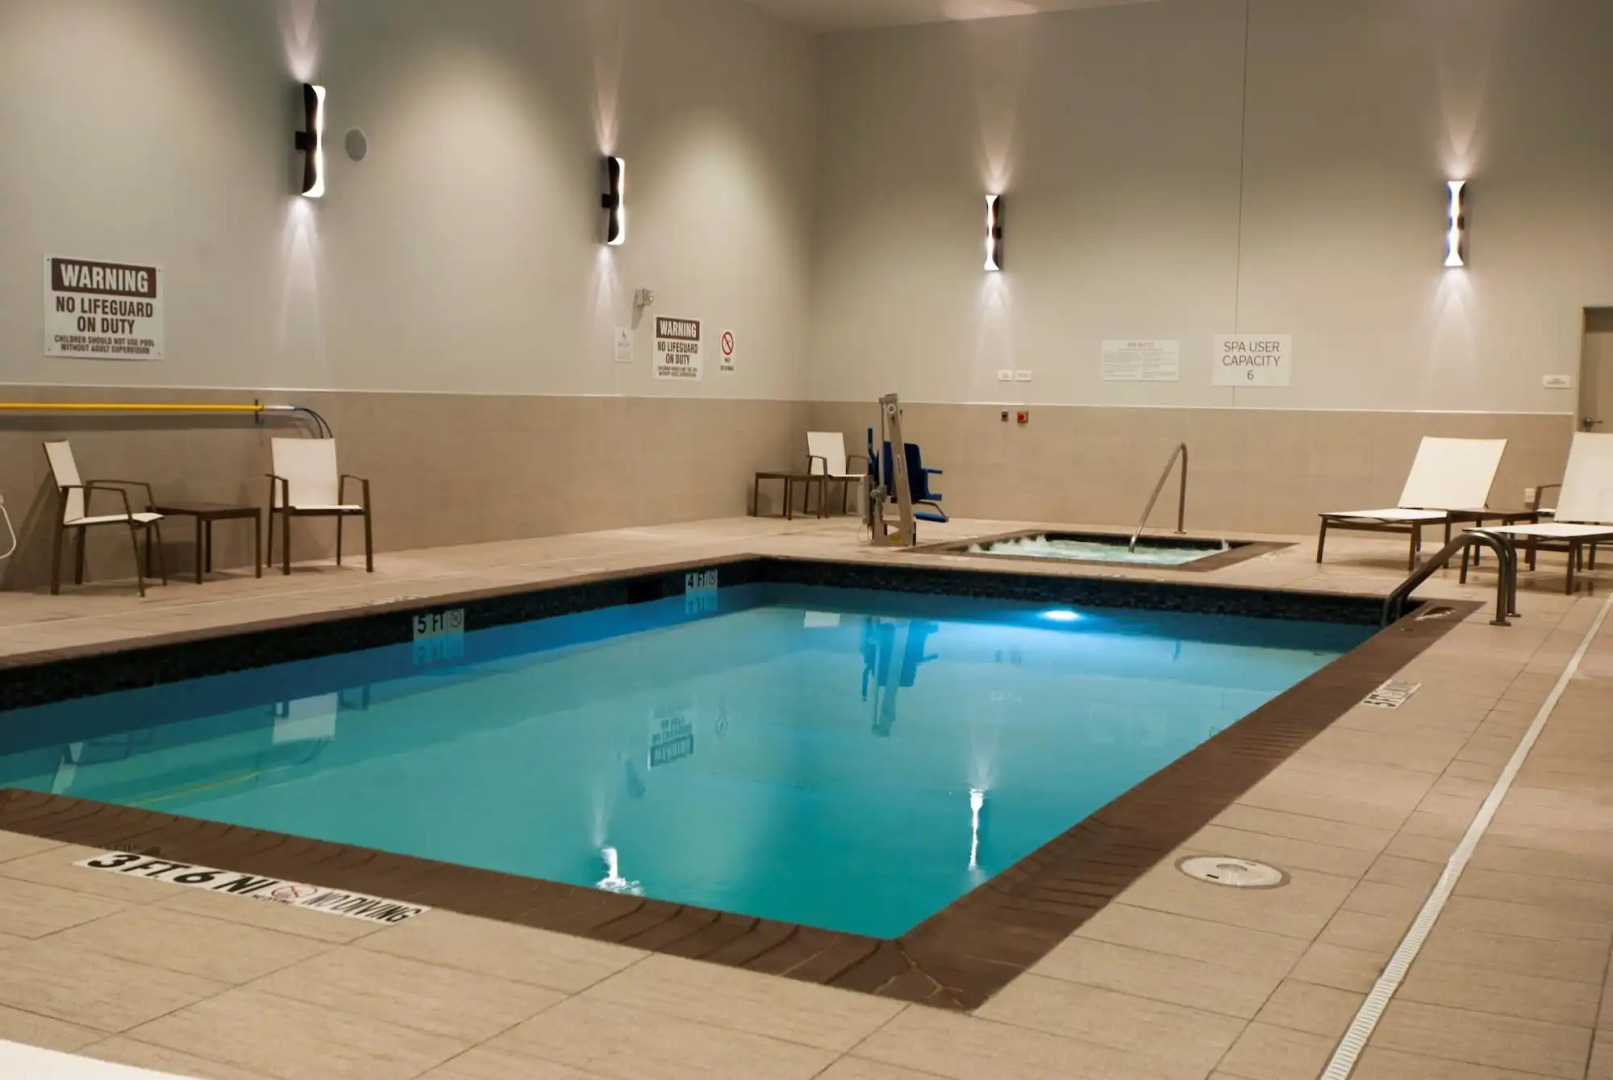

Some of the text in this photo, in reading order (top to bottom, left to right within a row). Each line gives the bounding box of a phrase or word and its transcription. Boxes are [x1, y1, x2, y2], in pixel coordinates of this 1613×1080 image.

[60, 263, 148, 293] WARNING
[56, 296, 153, 318] NO LIFEGUARD
[77, 316, 135, 334] ON DUTY
[660, 320, 697, 338] WARNING
[54, 335, 155, 347] CHILDREN SHOULD NOT USE POOL
[61, 344, 150, 354] WITHOUT ADULT SUPERVISION
[657, 341, 698, 354] NO LIFEGUARD
[1224, 341, 1280, 353] SPA USER
[665, 353, 691, 365] ON DUTY
[1222, 355, 1281, 367] CAPACITY
[1247, 369, 1255, 380] 6
[687, 572, 694, 589] 4
[417, 611, 445, 634] 5 FT
[87, 854, 141, 868] 3
[120, 860, 192, 877] FT
[173, 871, 228, 883] 6
[342, 897, 422, 922] DIVING
